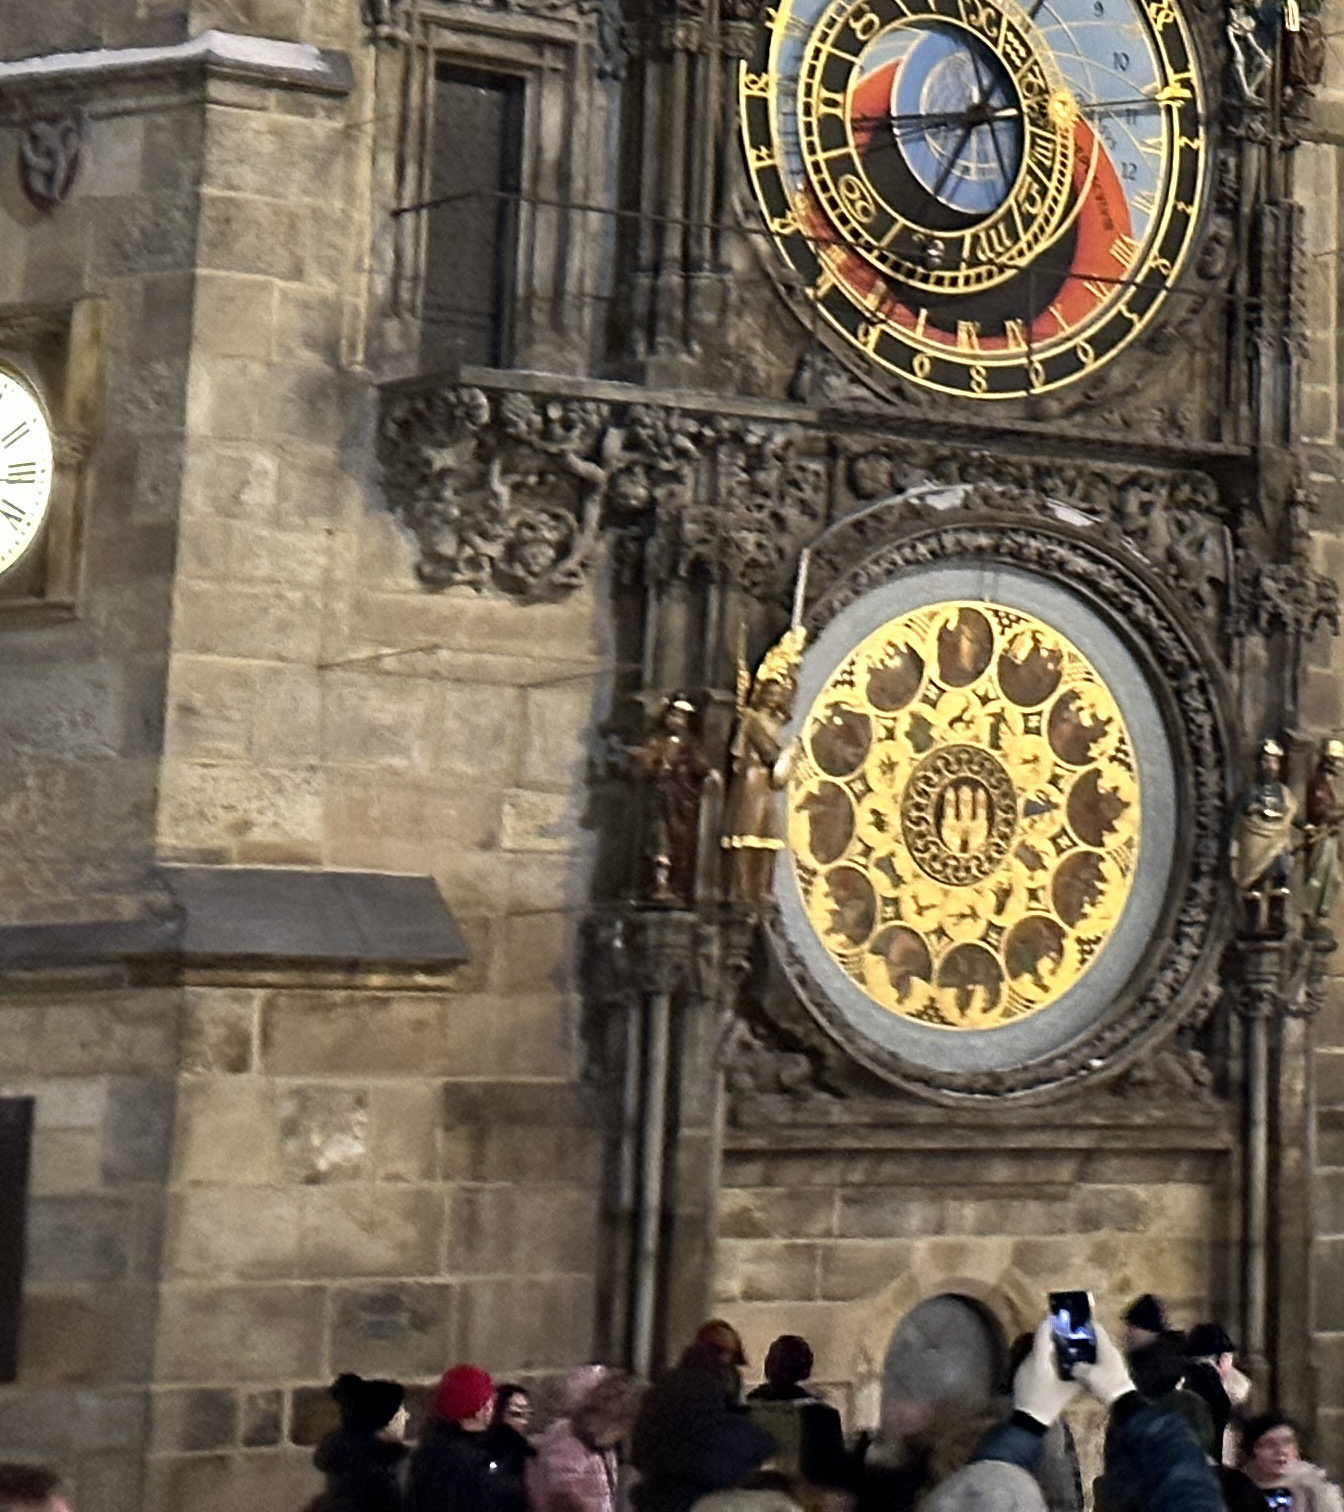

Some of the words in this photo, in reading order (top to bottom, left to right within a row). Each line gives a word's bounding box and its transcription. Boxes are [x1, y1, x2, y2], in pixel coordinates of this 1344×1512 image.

[1092, 0, 1105, 18] 9
[1111, 50, 1131, 72] 10
[1120, 161, 1138, 182] 12
